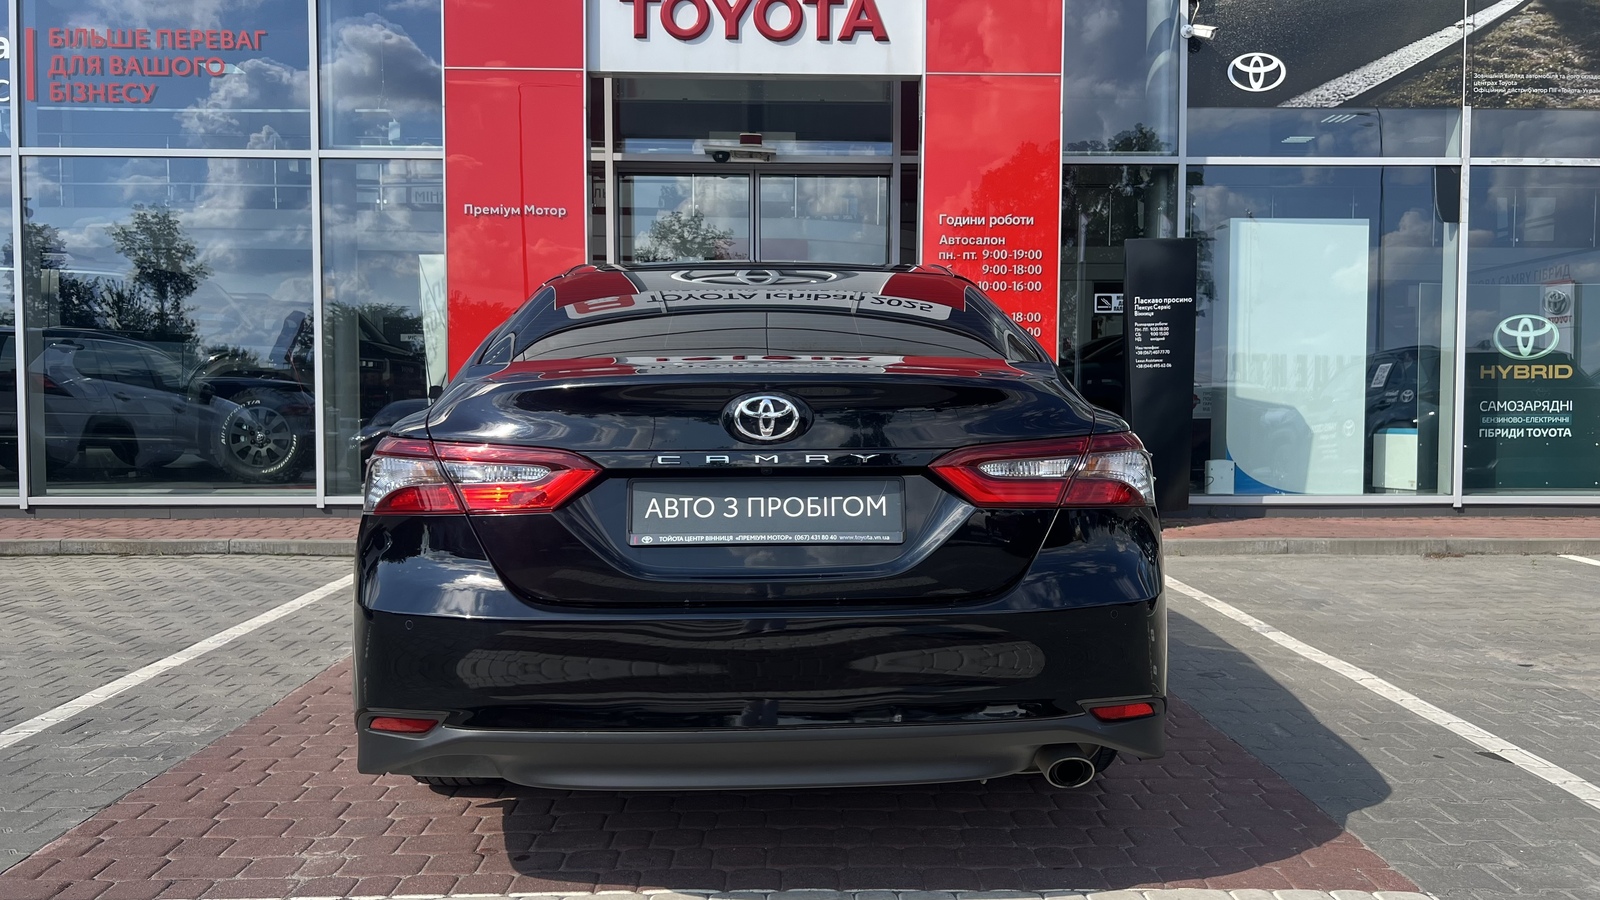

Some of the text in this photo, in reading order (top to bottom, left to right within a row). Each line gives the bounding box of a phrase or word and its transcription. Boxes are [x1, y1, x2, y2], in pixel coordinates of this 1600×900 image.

[618, 0, 890, 41] TOYOTA
[49, 28, 267, 49] БІЛЬШЕ ПЕРЕВАГ
[48, 55, 226, 77] ДЛЯ ВАШОГО
[49, 82, 157, 102] БІЗНЕСУ
[463, 204, 567, 217] Преміум Мотор
[939, 214, 1034, 228] Години роботи
[939, 235, 1006, 245] Автосалон
[982, 249, 1042, 260] 9:00-19:00
[982, 264, 1042, 275] 9:00-18:00
[977, 281, 1042, 291] 10:00-16:00
[1134, 296, 1162, 304] Ласкаво
[1480, 364, 1573, 379] HYBRID
[1480, 400, 1573, 413] САМОЗАРЯДНІ
[1479, 428, 1572, 438] ГІБРИДИ TOYOTA
[657, 453, 880, 464] CAMRY
[644, 496, 887, 518] АВТО З ПРОБІГОМ
[684, 535, 704, 543] ЦЕНТР
